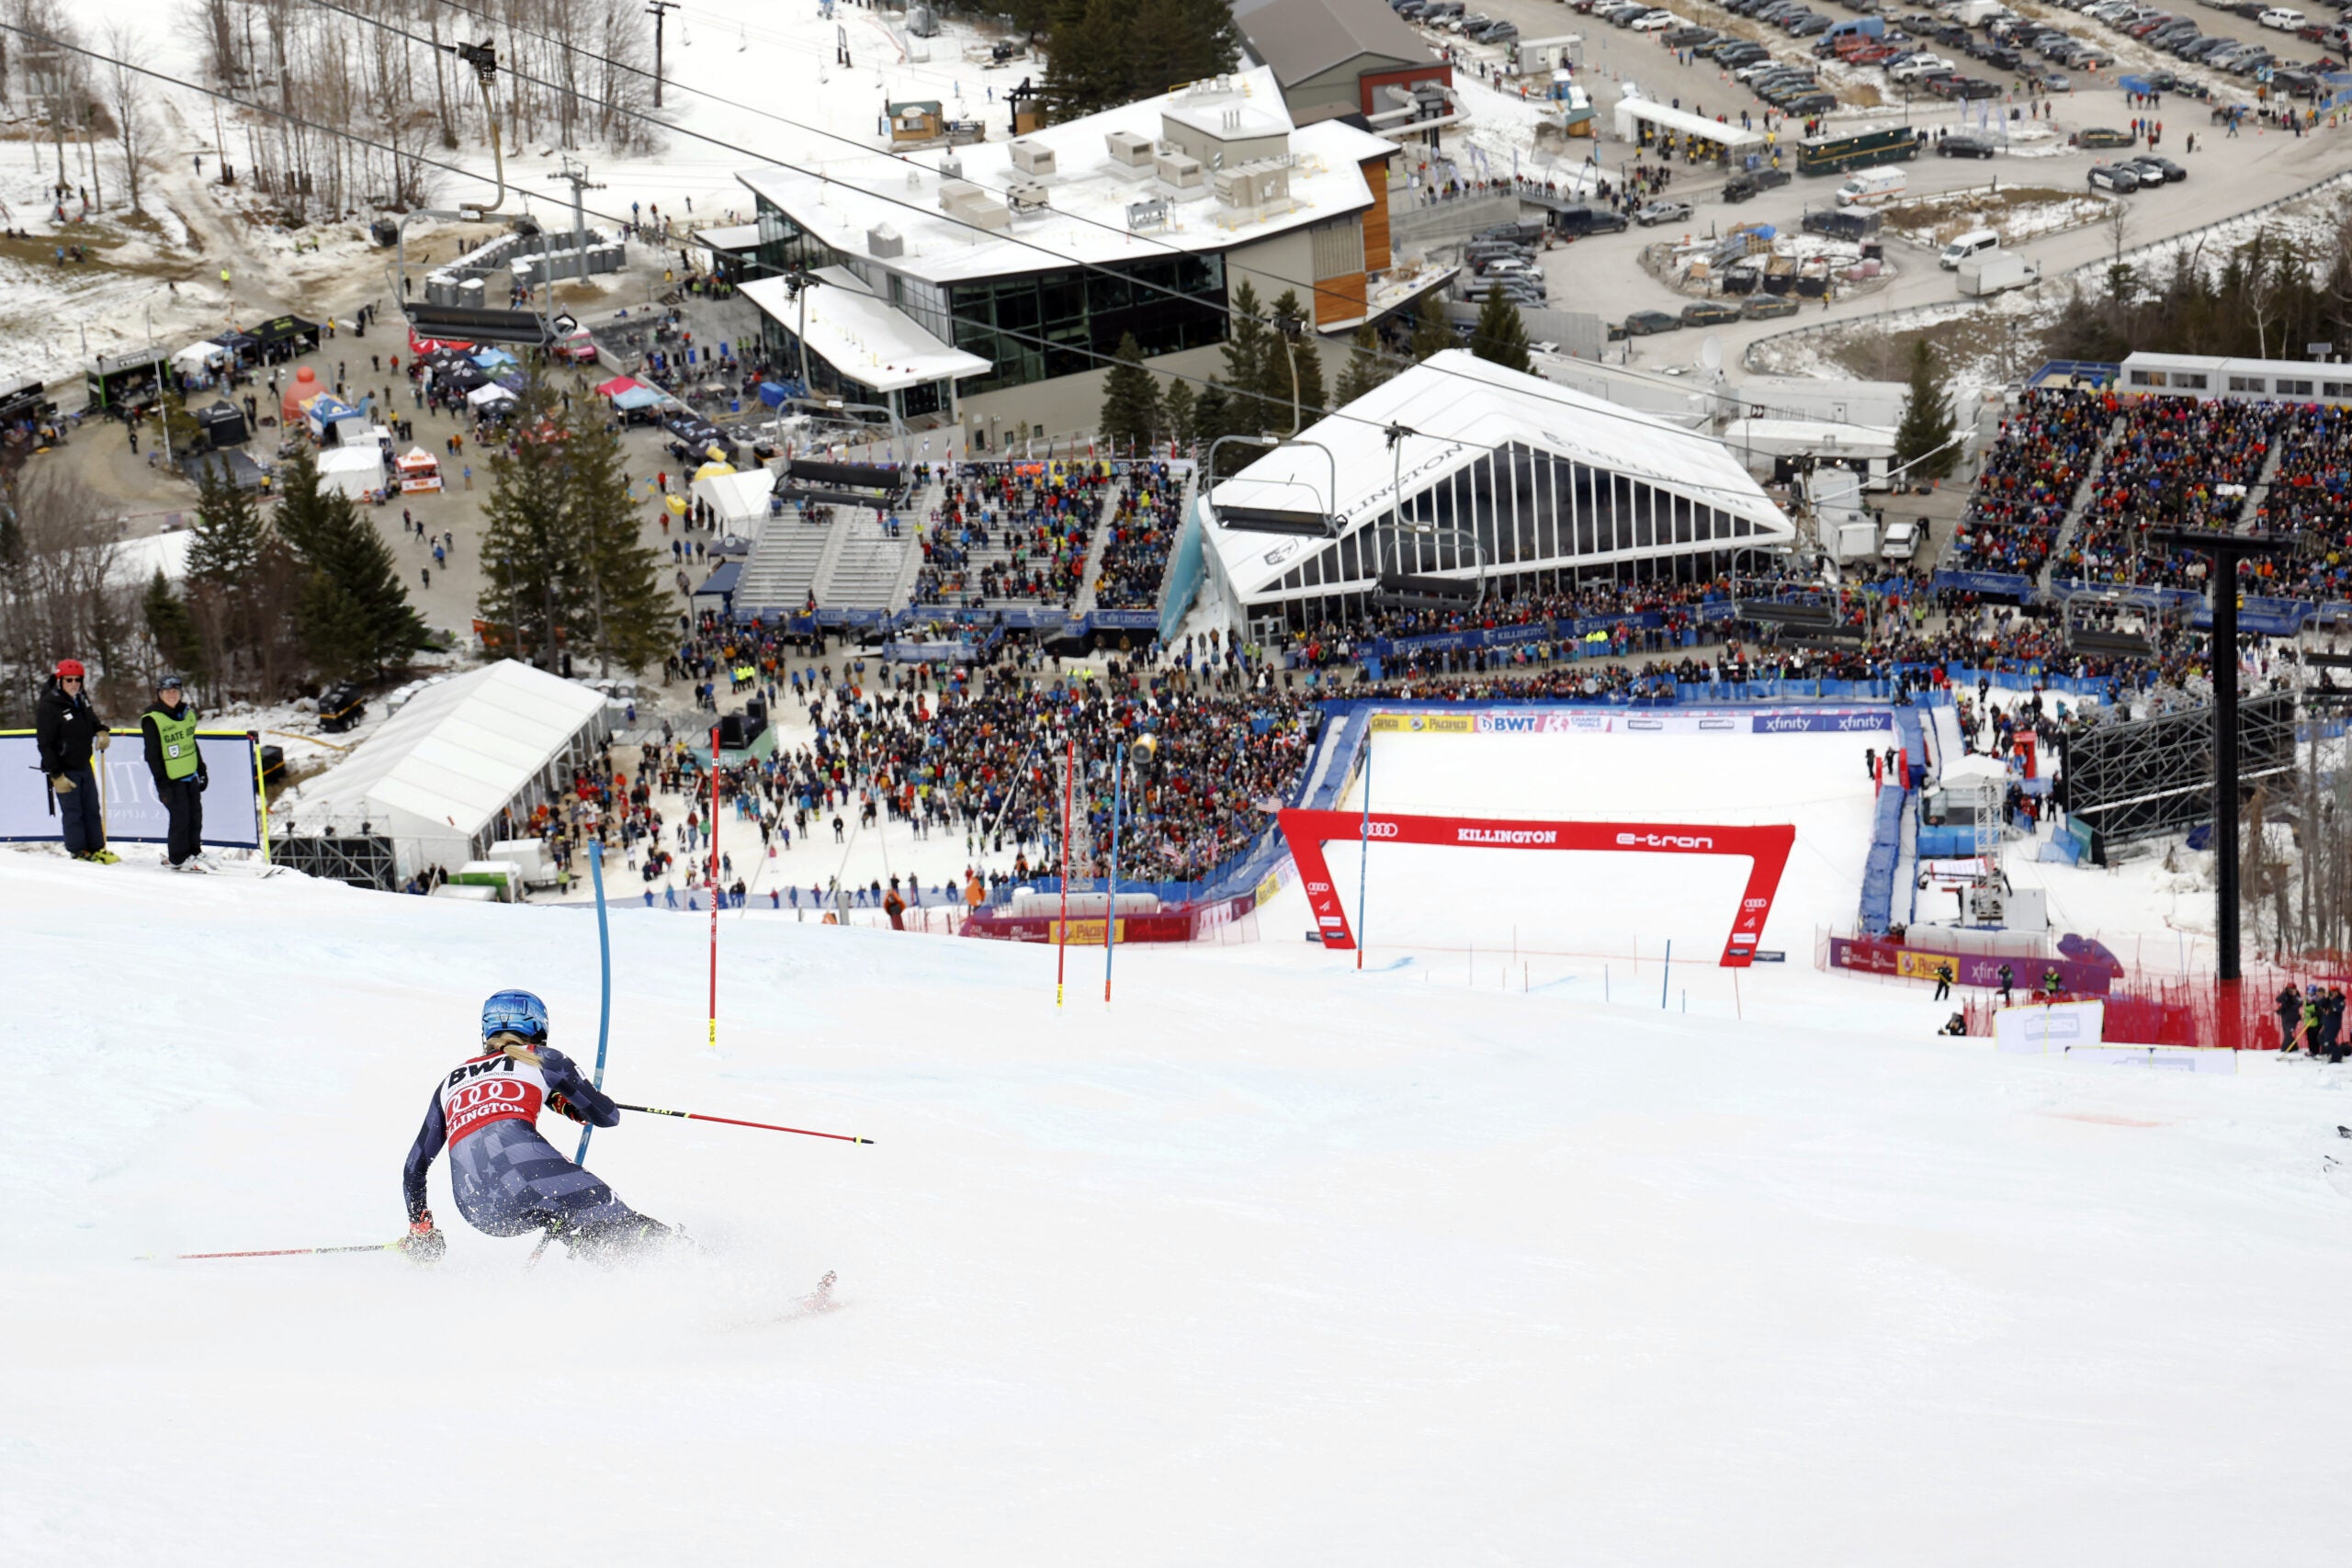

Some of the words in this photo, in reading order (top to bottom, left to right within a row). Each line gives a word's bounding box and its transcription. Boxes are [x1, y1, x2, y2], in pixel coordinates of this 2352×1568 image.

[1494, 717, 1535, 731] BWT
[1766, 717, 1811, 731] xfinity
[1838, 716, 1883, 731] xfinity
[164, 730, 184, 743] GATE
[1457, 828, 1557, 843] KILLINGTON
[1616, 832, 1713, 849] e-tron
[646, 1107, 673, 1115] LEKI
